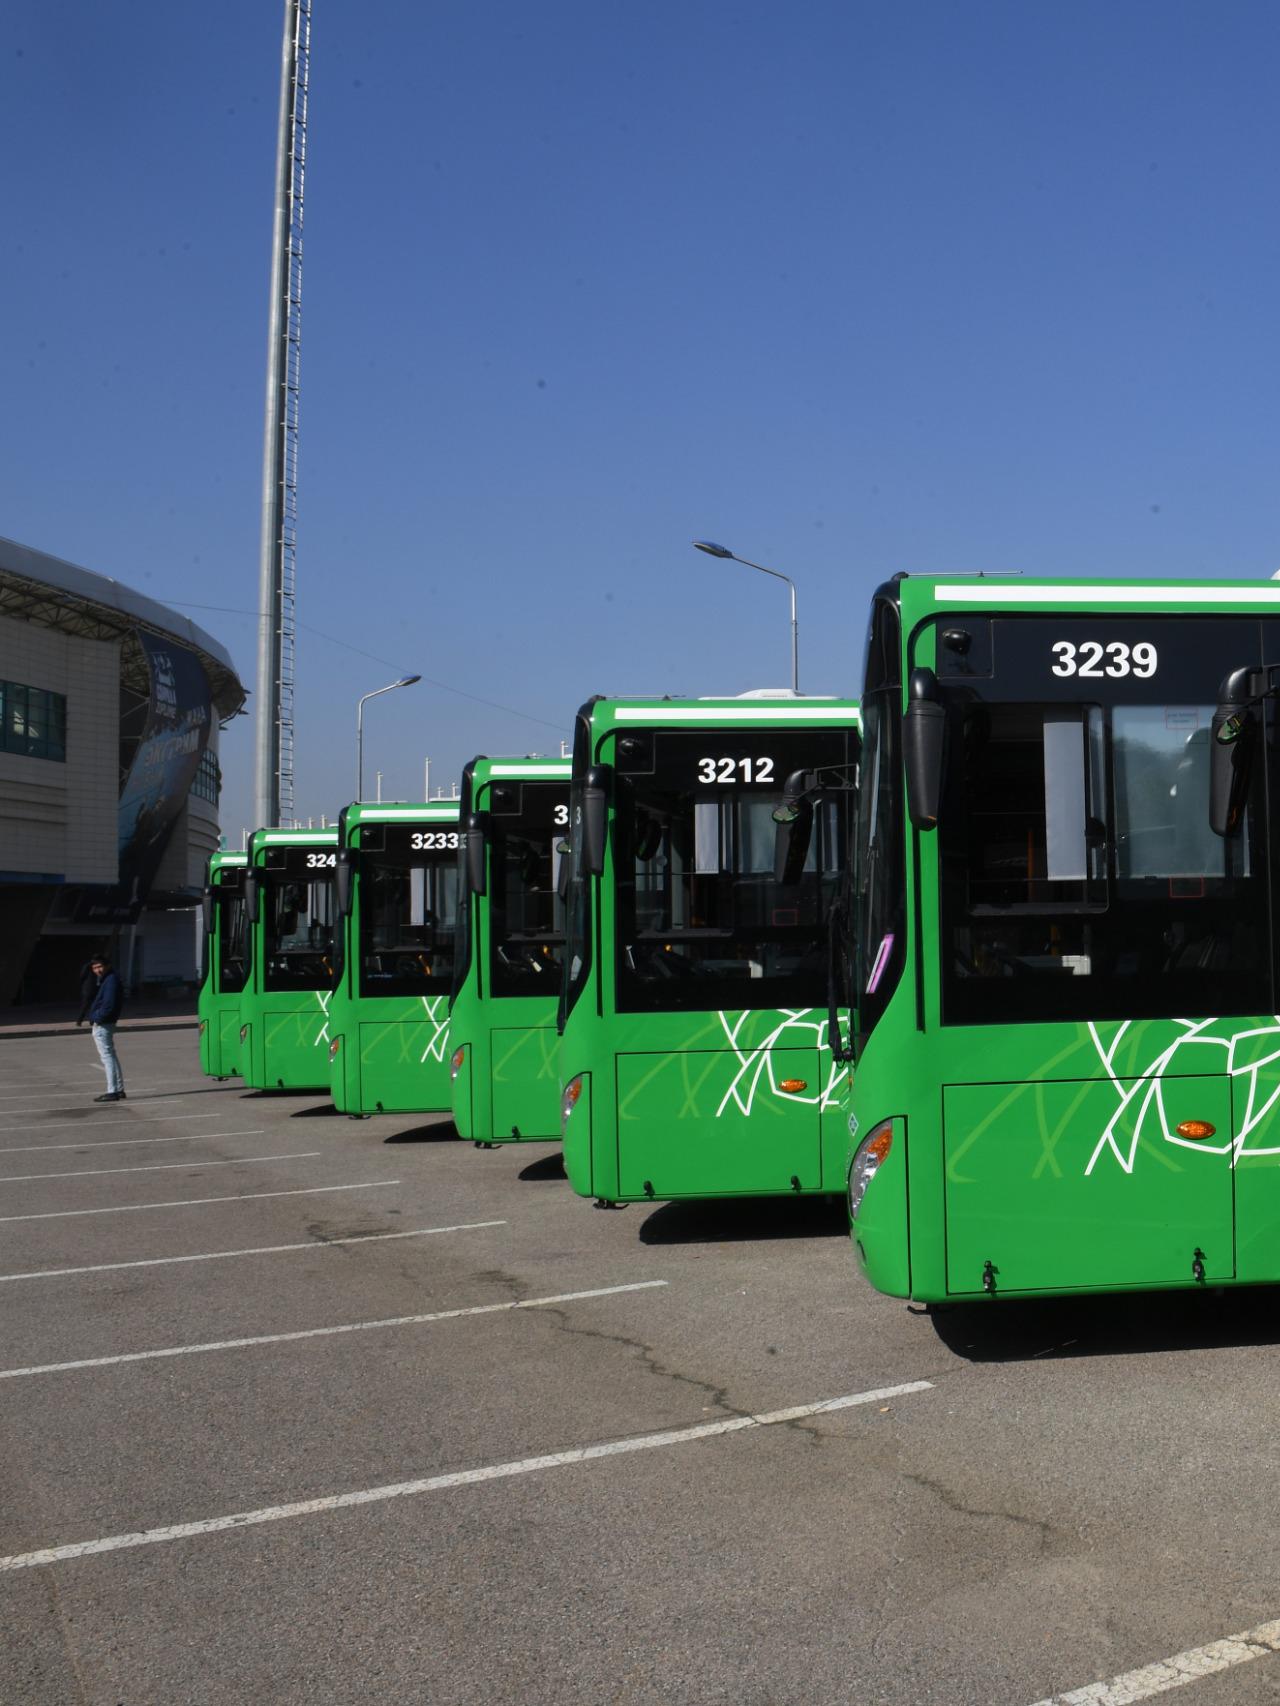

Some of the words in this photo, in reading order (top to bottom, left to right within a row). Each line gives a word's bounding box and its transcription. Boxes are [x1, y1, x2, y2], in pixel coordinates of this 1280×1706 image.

[1051, 641, 1158, 678] 3239
[697, 757, 775, 785] 3212
[411, 832, 459, 850] 3233
[306, 853, 337, 868] 324
